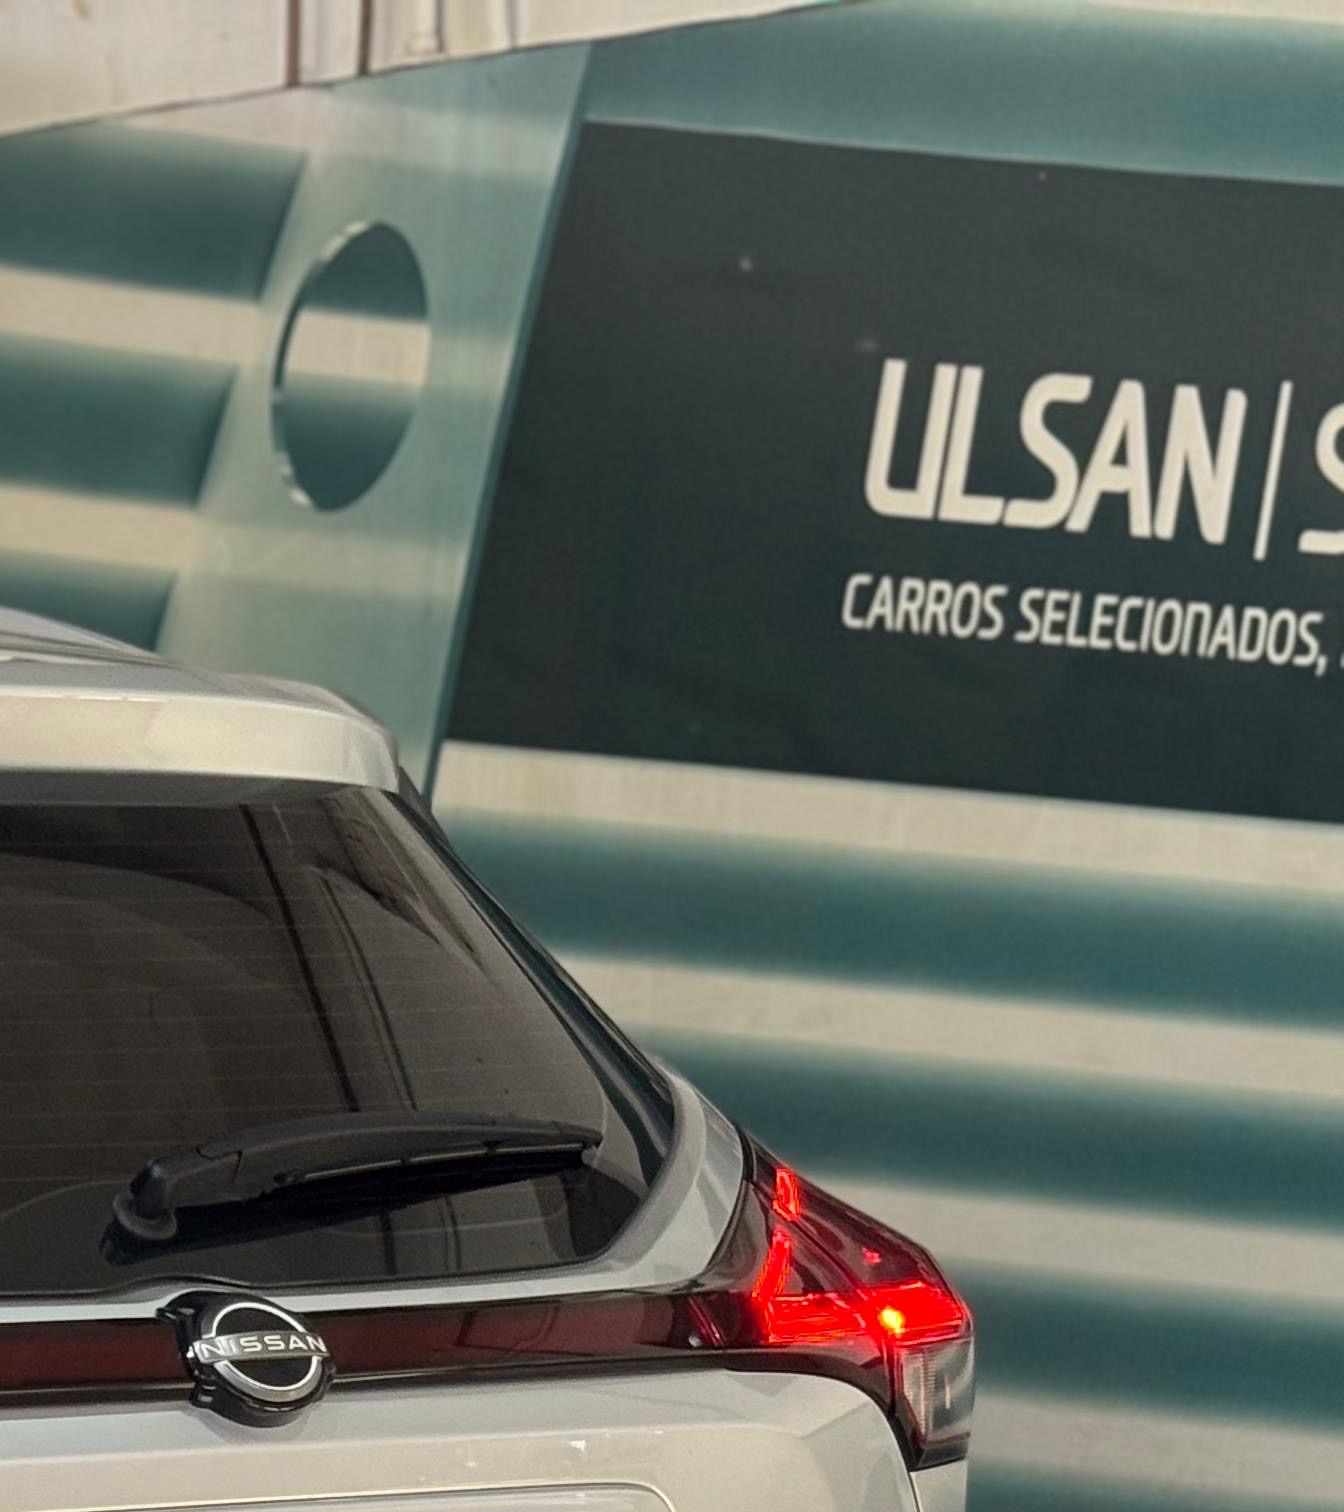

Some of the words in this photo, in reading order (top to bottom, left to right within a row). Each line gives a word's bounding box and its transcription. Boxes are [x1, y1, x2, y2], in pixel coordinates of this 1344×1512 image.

[864, 358, 1248, 545] ULSAN
[842, 573, 1009, 641] CARROS
[1014, 588, 1329, 676] SELECIONADOS,
[201, 1335, 328, 1358] NISSAN
